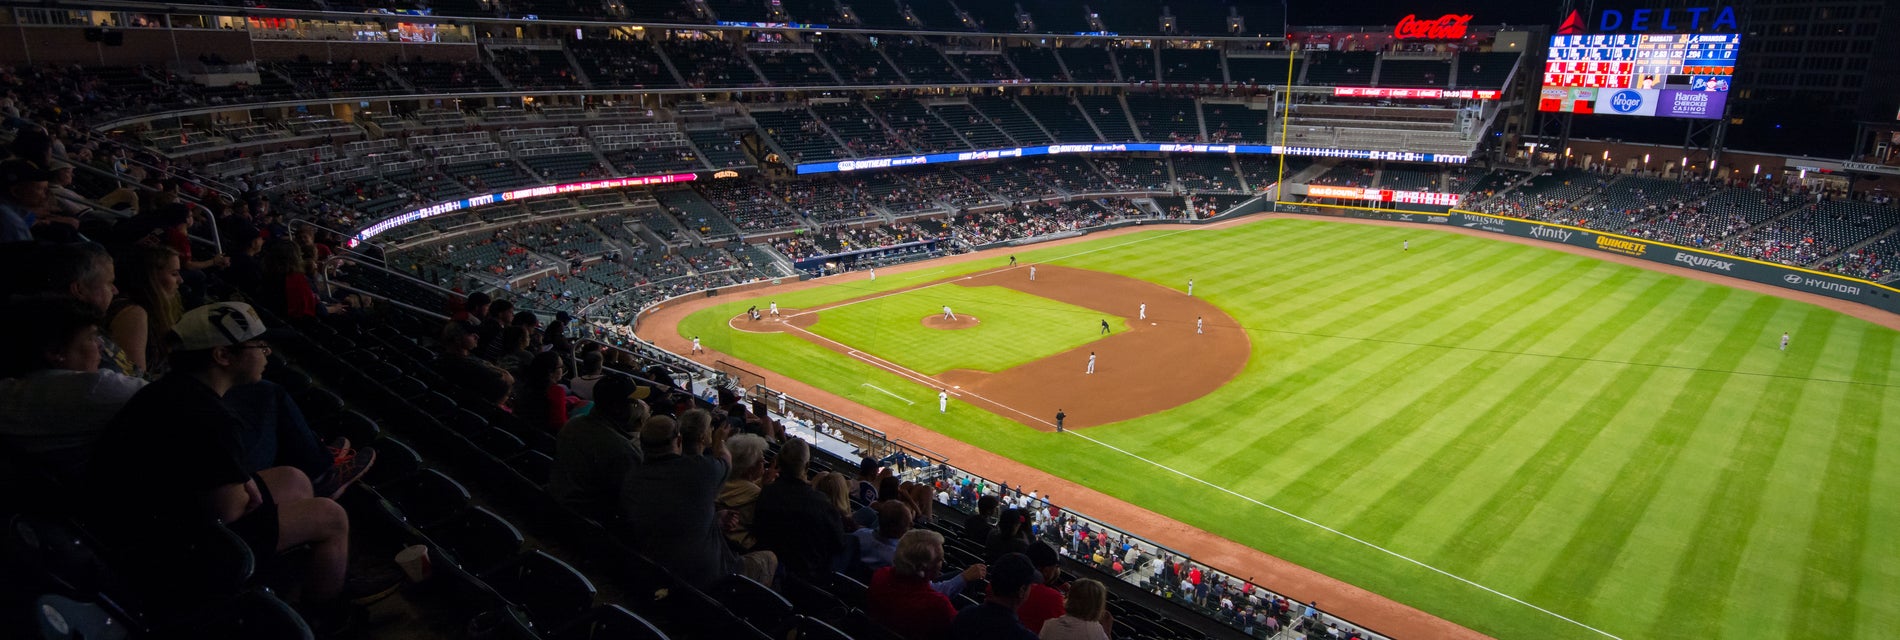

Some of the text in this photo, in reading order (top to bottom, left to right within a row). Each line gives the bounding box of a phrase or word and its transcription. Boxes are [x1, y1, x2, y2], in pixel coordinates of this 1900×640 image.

[1601, 6, 1737, 31] DELTA
[1549, 62, 1561, 73] AL
[1613, 93, 1640, 111] Kroger
[1332, 188, 1355, 197] SOUTH
[1529, 225, 1573, 242] xfinity
[1596, 235, 1647, 253] QUIKRETE
[1674, 252, 1735, 272] EQUIFAX
[1805, 278, 1861, 295] HYUNDAI
